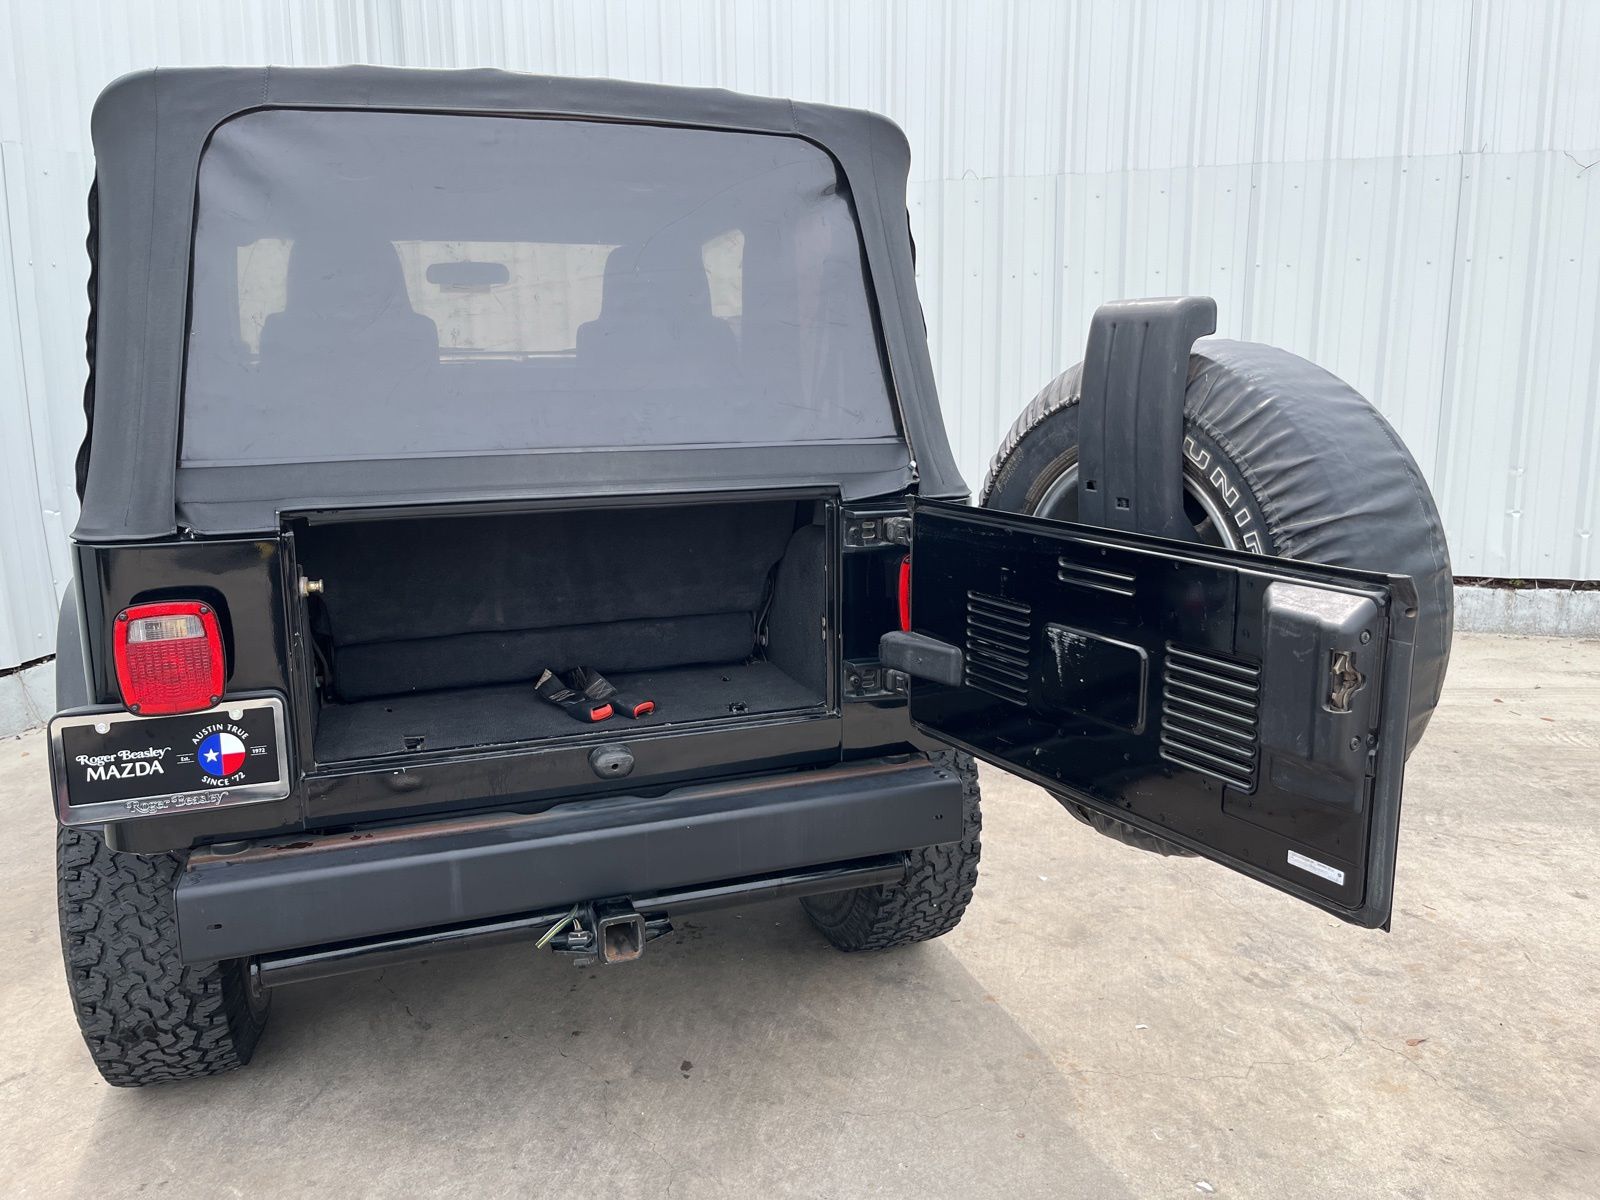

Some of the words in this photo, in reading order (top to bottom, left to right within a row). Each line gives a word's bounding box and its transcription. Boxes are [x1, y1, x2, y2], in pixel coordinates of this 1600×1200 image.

[192, 723, 223, 745] AUSTIN
[227, 723, 249, 741] TRUE
[76, 754, 116, 768] Roger
[117, 746, 172, 762] Beasley
[86, 761, 164, 782] MAZDA
[201, 775, 230, 787] SINCE
[231, 771, 246, 783] '72
[125, 799, 170, 814] Roger
[171, 791, 229, 808] Beasley
